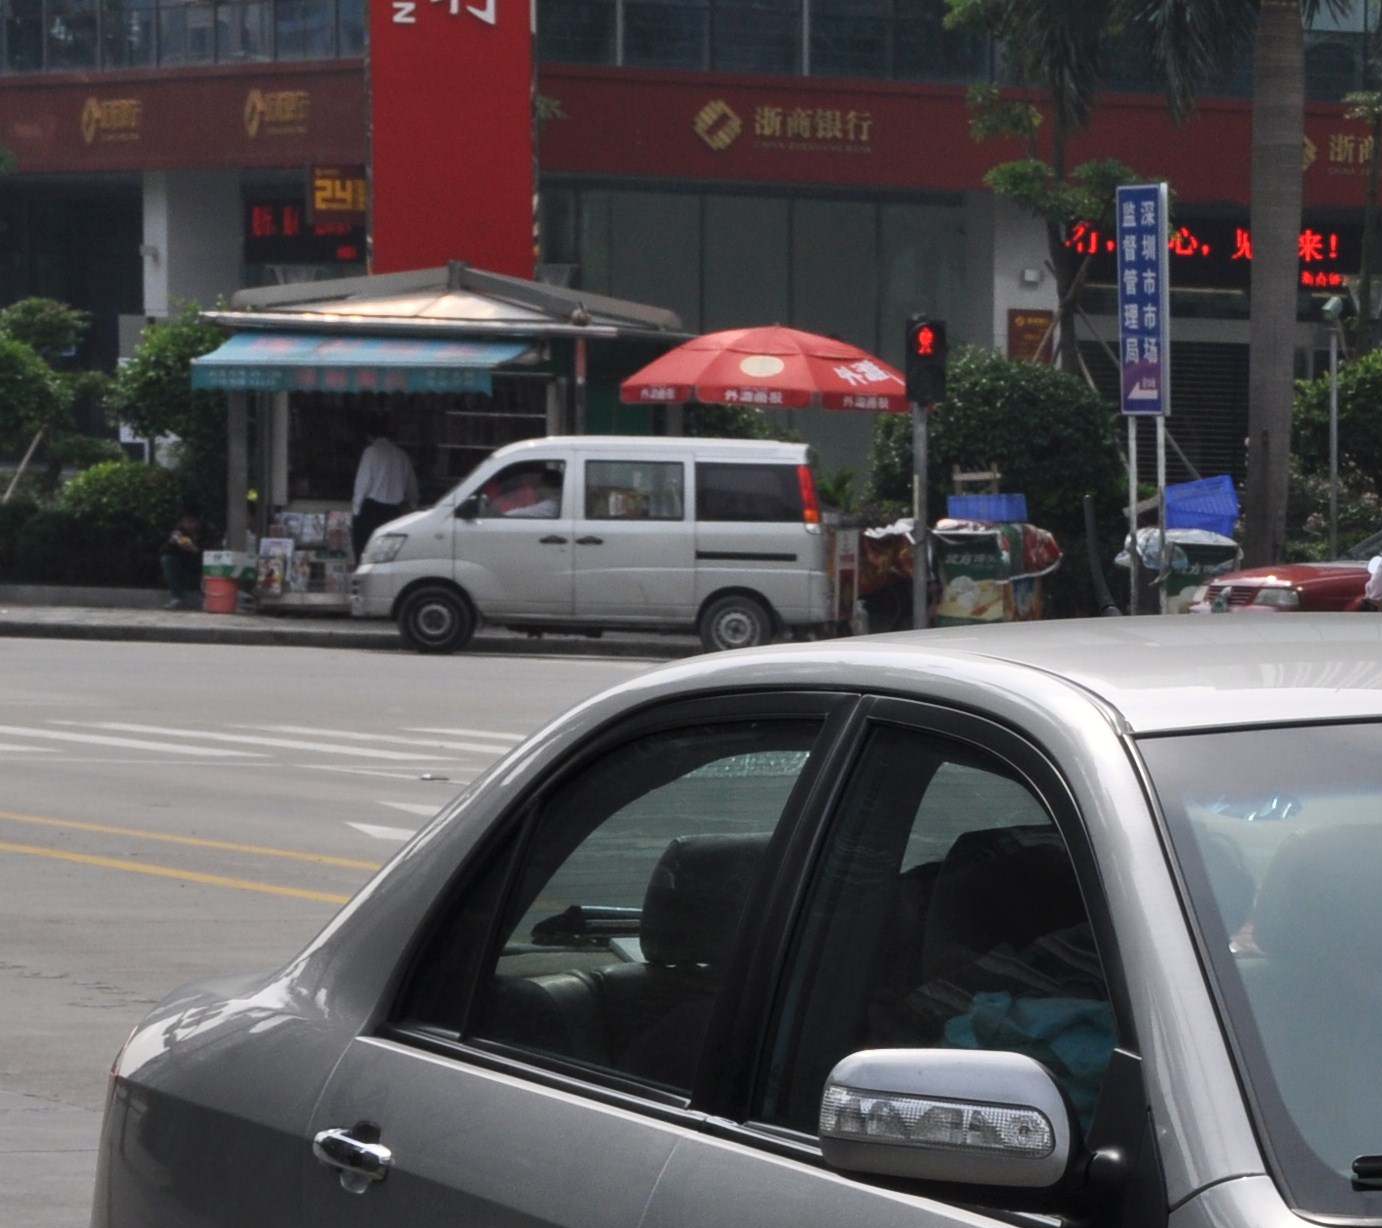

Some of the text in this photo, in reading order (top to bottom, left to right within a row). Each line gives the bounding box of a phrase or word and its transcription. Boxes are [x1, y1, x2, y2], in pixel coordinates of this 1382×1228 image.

[754, 106, 873, 142] 浙商银行
[1121, 202, 1141, 365] 监督管理局
[1140, 200, 1159, 365] 深圳市市场
